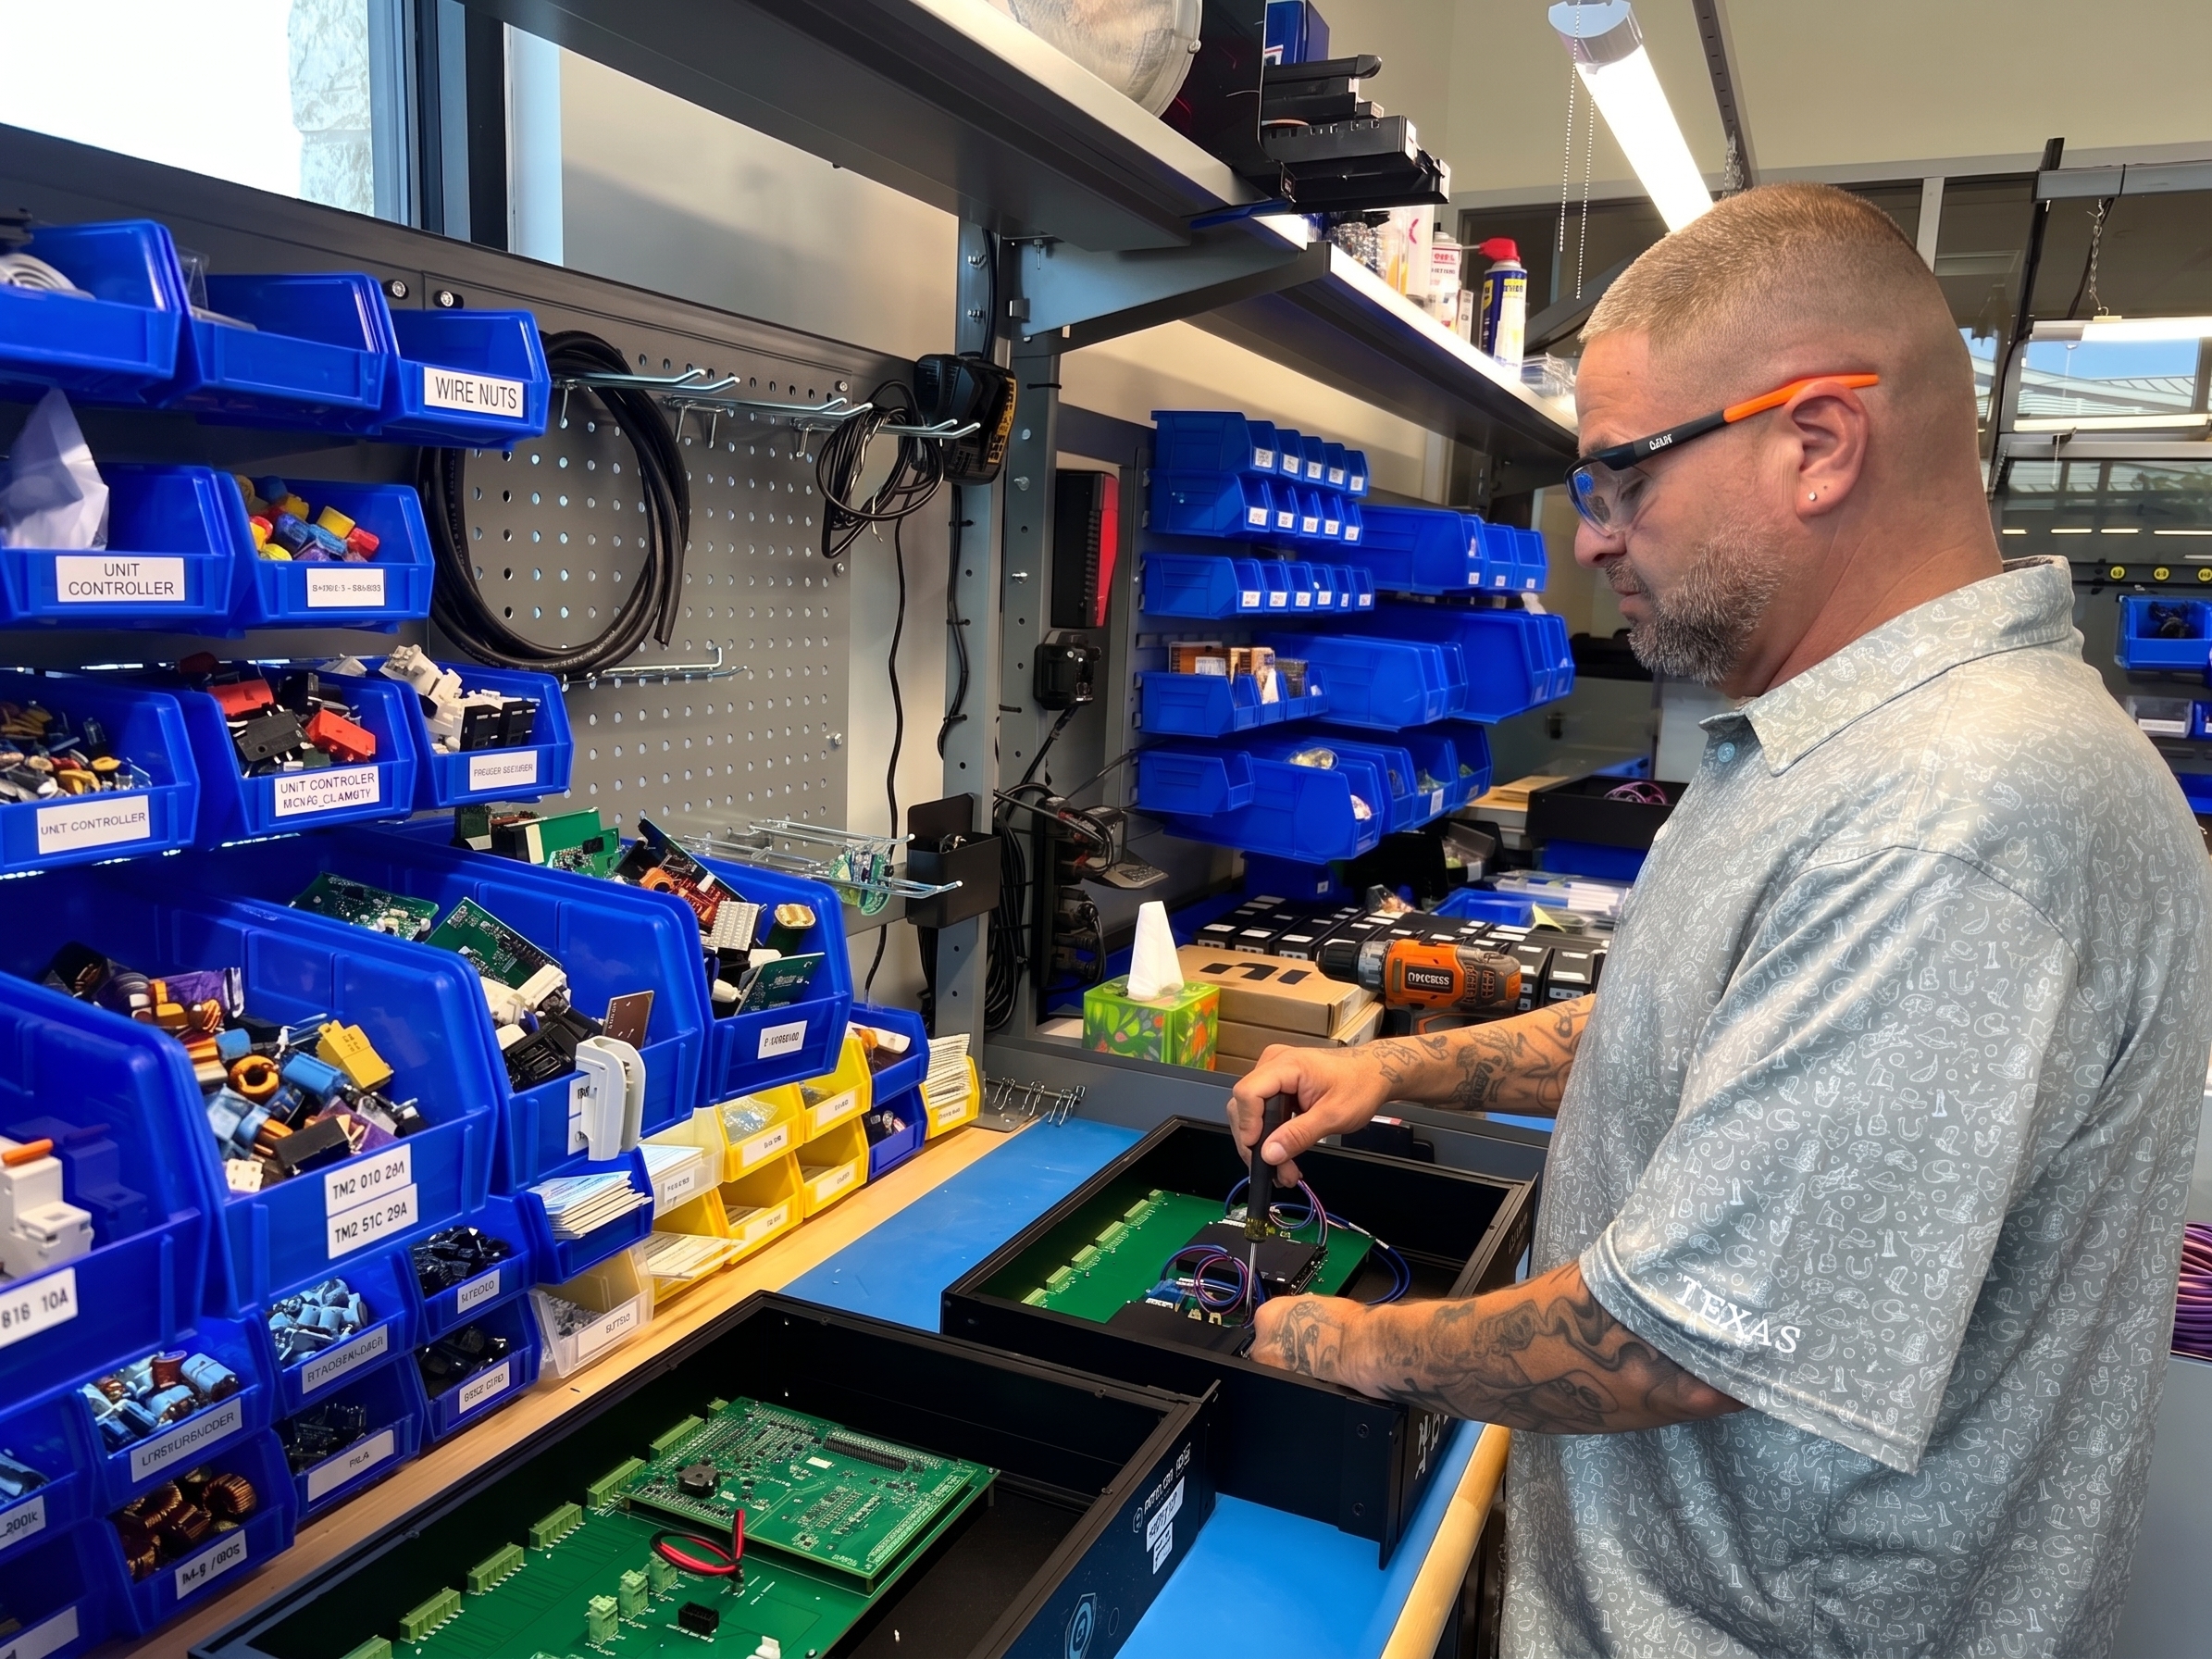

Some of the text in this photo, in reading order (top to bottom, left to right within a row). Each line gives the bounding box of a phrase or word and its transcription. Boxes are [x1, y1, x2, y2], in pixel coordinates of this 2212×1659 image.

[435, 376, 517, 409] WIRE NUTS
[104, 563, 140, 577] UNIT
[68, 581, 175, 595] CONTROLLER
[309, 772, 375, 791] CONTROLER
[70, 812, 146, 831] CONTROLLER
[332, 1179, 355, 1200] TM2
[335, 1221, 358, 1243] TM2
[387, 1201, 407, 1222] 29A
[42, 1286, 68, 1313] 10A
[1671, 1275, 1801, 1353] TEXAS
